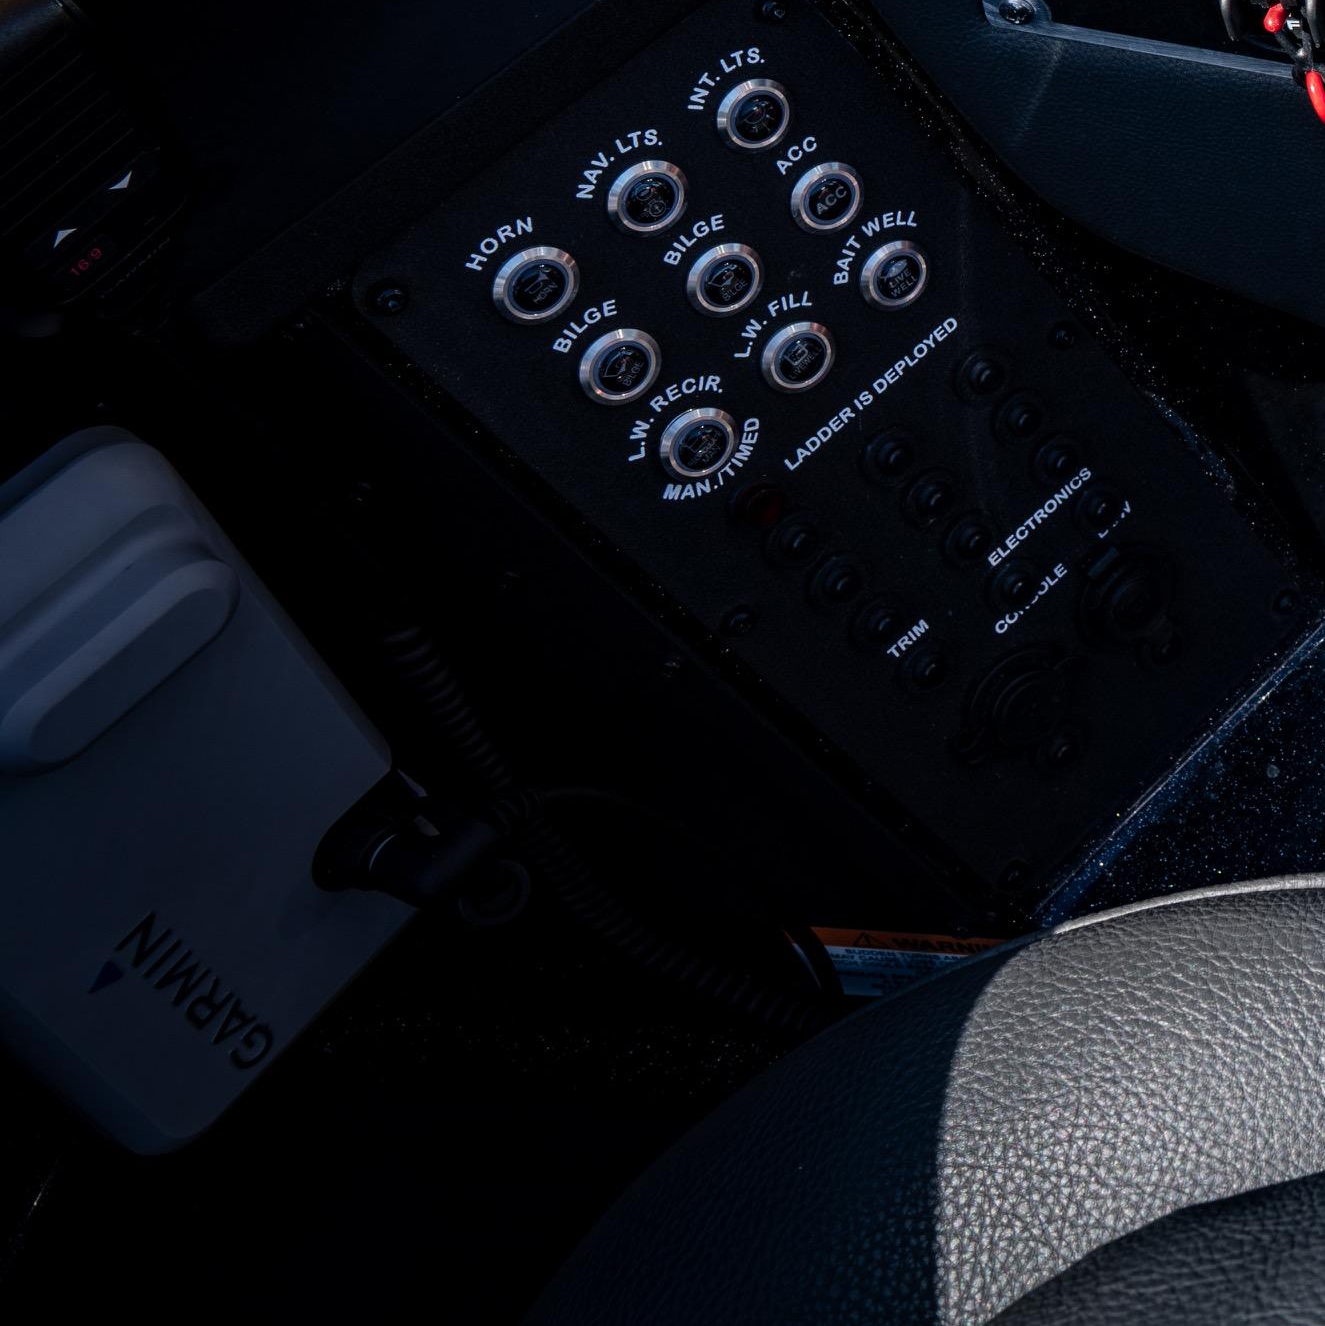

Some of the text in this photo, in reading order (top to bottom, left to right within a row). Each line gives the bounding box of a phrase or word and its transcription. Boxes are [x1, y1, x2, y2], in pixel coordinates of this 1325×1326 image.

[687, 47, 765, 110] INT. LTS.
[575, 129, 663, 200] NAV. LTS.
[776, 136, 818, 175] ACC
[815, 185, 848, 215] ACC
[465, 217, 533, 271] HORN
[663, 214, 725, 266] BILGE
[833, 211, 918, 286] BAIT WELL
[534, 282, 558, 304] HORN
[722, 279, 748, 301] BILGE
[889, 268, 912, 288] LIVE
[891, 275, 918, 297] WELL
[553, 299, 618, 354] BILGE
[734, 291, 813, 358] L.W. FILL
[622, 361, 645, 387] BILGE
[784, 407, 856, 470] LADDER
[854, 391, 874, 410] IS
[873, 317, 958, 394] DEPLOYED
[628, 418, 655, 462] L.W.
[650, 375, 723, 412] RECIR.
[988, 467, 1093, 567] ELECTRONICS
[995, 563, 1068, 634] COOLE
[886, 619, 929, 658] TRIM
[114, 912, 273, 1070] GARMIN
